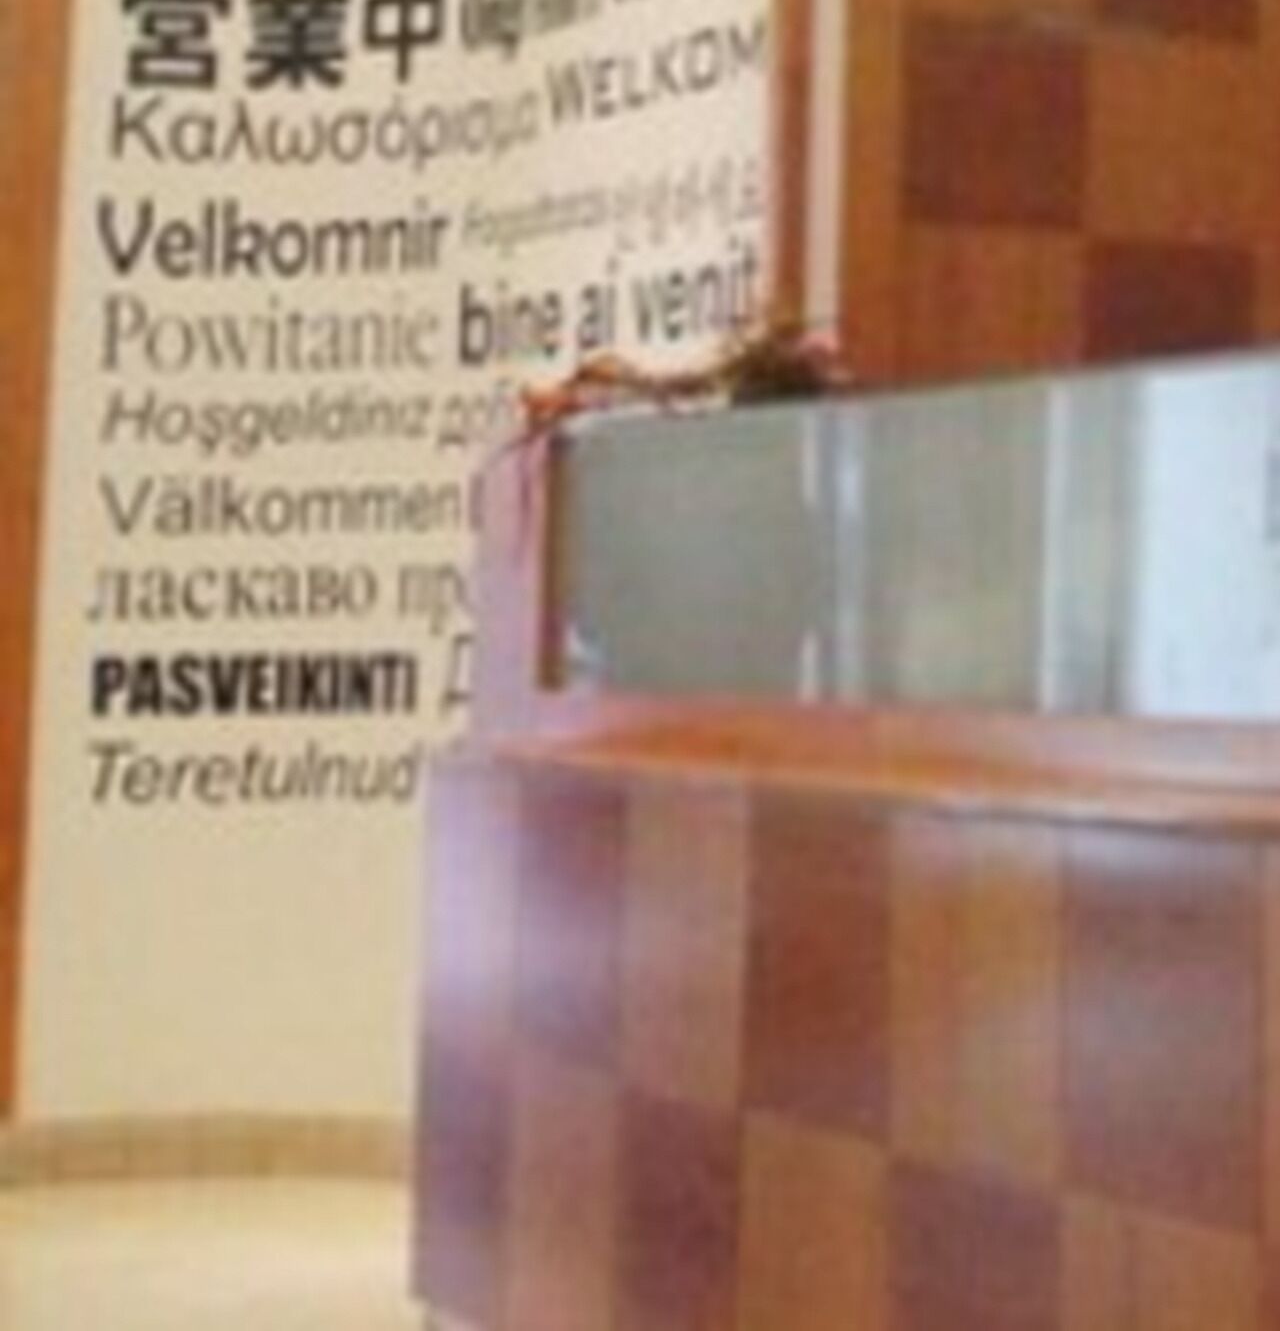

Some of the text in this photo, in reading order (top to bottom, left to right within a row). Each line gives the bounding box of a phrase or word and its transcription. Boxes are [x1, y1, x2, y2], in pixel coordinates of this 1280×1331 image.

[96, 193, 450, 279] Velkomnir
[102, 291, 442, 373] Powitanie
[90, 653, 420, 717] PASVEIKINTI
